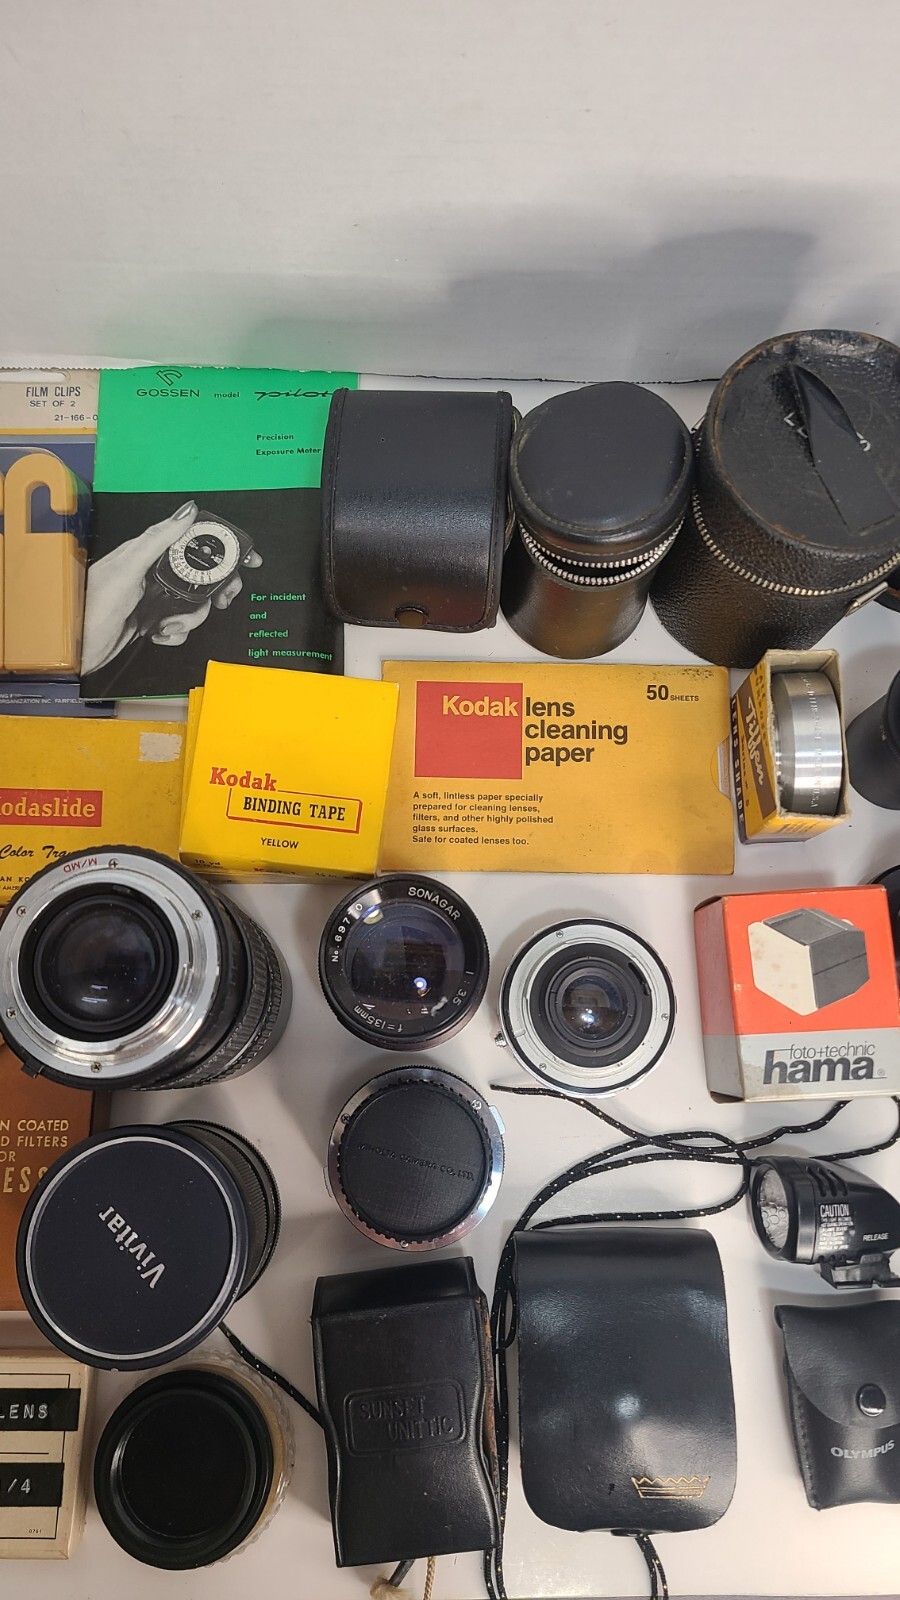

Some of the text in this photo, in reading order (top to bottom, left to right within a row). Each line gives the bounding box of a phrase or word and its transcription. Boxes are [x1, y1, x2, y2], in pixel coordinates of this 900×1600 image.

[26, 386, 81, 397] FILM CLIPS
[136, 388, 200, 398] GOSSEN
[254, 388, 333, 401] pilot
[256, 448, 294, 457] Exposure
[250, 593, 266, 601] For
[248, 649, 332, 660] light measurement
[646, 684, 669, 701] 50
[441, 694, 575, 717] Kodak lens
[525, 719, 628, 745] cleaning
[745, 696, 763, 786] Tiffen
[525, 745, 595, 766] paper
[209, 766, 277, 792] Kodak
[422, 792, 441, 800] soft,
[478, 794, 502, 802] paper
[505, 794, 543, 803] specially
[735, 759, 744, 823] SHADE
[0, 796, 96, 818] odaslide
[243, 796, 346, 821] BINDING TAPE
[413, 803, 452, 811] prepared
[469, 804, 506, 813] cleaning
[510, 805, 540, 813] lenses,
[412, 813, 440, 822] filters,
[487, 815, 513, 824] highly
[516, 816, 554, 824] polished
[412, 825, 435, 833] glass
[261, 837, 299, 849] YELLOW
[0, 844, 71, 859] Color Tra
[63, 857, 98, 873] M/MD
[408, 886, 461, 921] SONAGAR
[789, 1040, 876, 1060] foto+technic
[763, 1050, 874, 1084] hama
[17, 1120, 69, 1131] COATED
[1, 1136, 68, 1147] D FILTERS
[0, 1151, 16, 1162] OR
[820, 1204, 850, 1217] CAUTION
[862, 1232, 889, 1241] RELEASE
[98, 1206, 166, 1289] Vivitar
[360, 1396, 426, 1421] SUNSET
[830, 1440, 895, 1459] OLYMPUS
